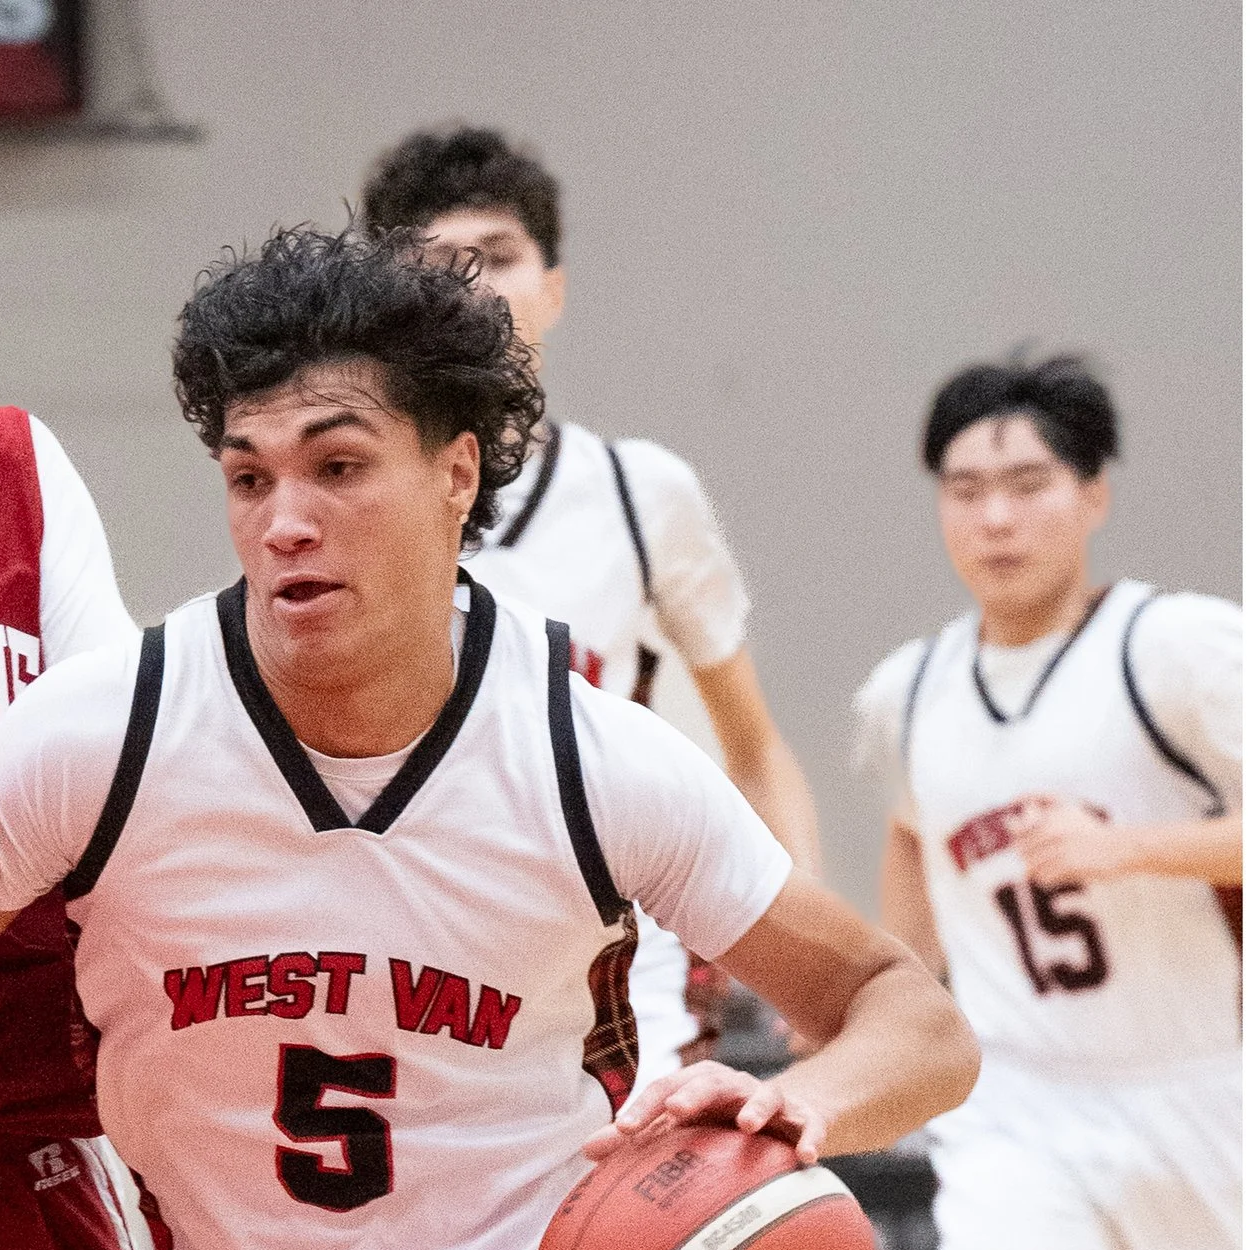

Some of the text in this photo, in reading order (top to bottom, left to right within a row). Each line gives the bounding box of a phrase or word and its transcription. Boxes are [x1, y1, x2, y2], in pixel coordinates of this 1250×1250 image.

[994, 876, 1112, 998] 15
[164, 951, 523, 1050] WEST VAN
[273, 1043, 398, 1213] 5
